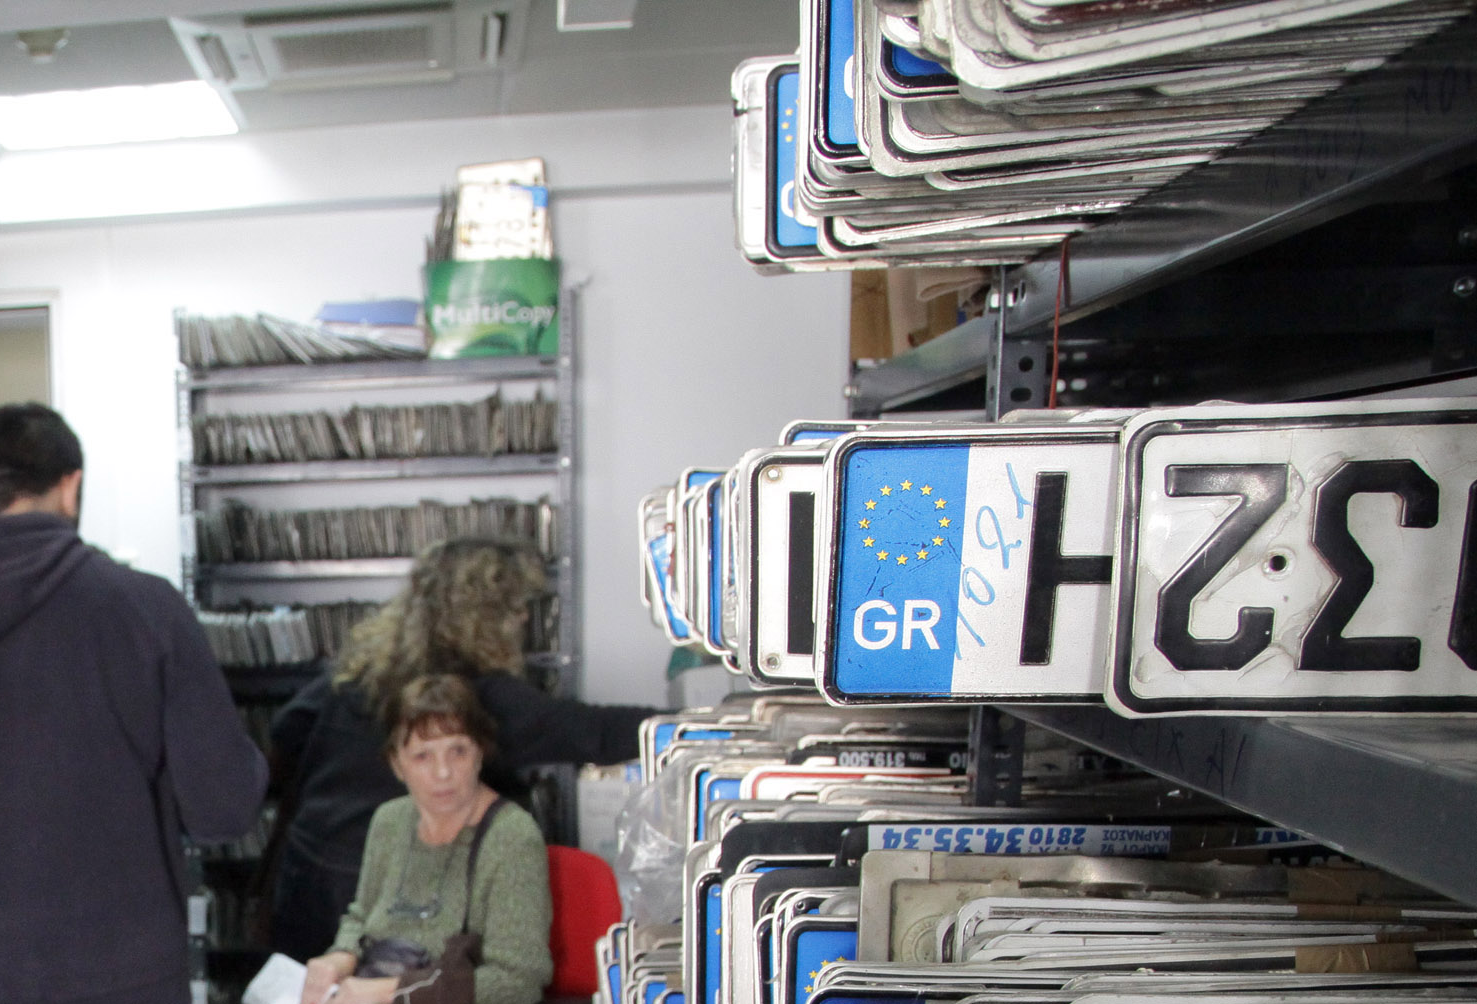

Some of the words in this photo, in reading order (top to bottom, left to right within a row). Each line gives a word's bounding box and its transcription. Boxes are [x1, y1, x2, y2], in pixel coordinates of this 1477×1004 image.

[431, 300, 556, 328] MultiCopy
[1153, 458, 1477, 672] 32
[853, 599, 942, 650] GR
[838, 752, 906, 768] 319.500
[1028, 827, 1086, 846] 2810
